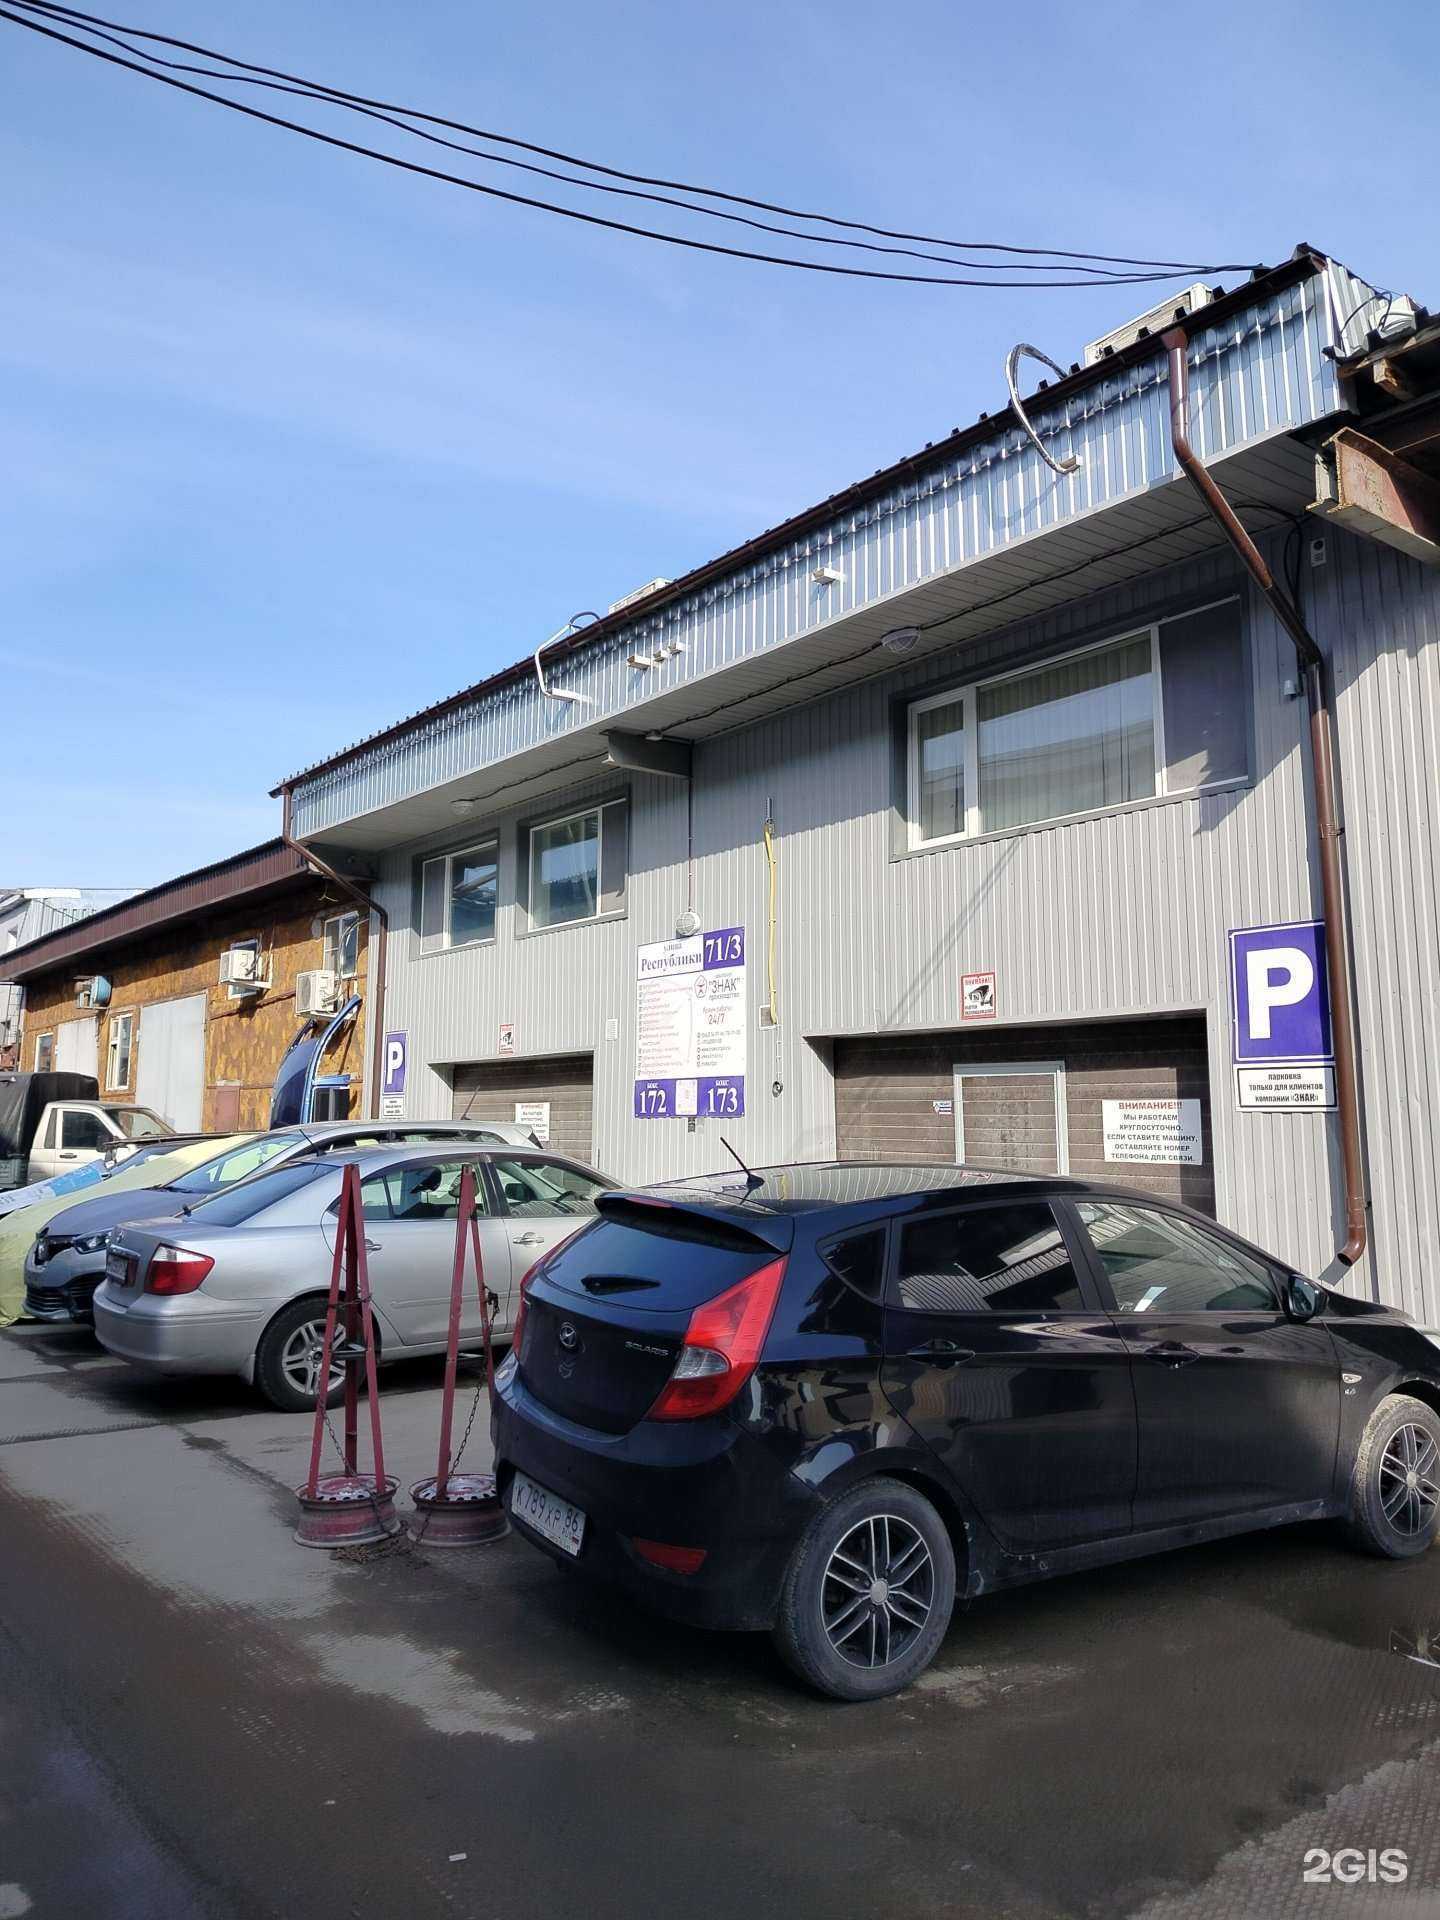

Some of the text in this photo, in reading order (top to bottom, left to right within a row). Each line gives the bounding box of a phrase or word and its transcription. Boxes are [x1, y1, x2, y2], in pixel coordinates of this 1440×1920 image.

[641, 935, 741, 971] Республики 71/3
[1247, 947, 1314, 1040] P
[708, 1013, 725, 1025] 24/7
[386, 1041, 404, 1085] P
[1268, 1073, 1301, 1081] парковка
[1249, 1083, 1273, 1091] только
[1289, 1082, 1324, 1090] клиентов
[640, 1089, 667, 1114] 172
[708, 1087, 738, 1113] 173
[1119, 1102, 1182, 1110] ВНИМАНИЕ!!!
[1114, 1143, 1162, 1151] ОСТАВЛЯЙТЕ
[624, 1341, 669, 1356] SOLARIS
